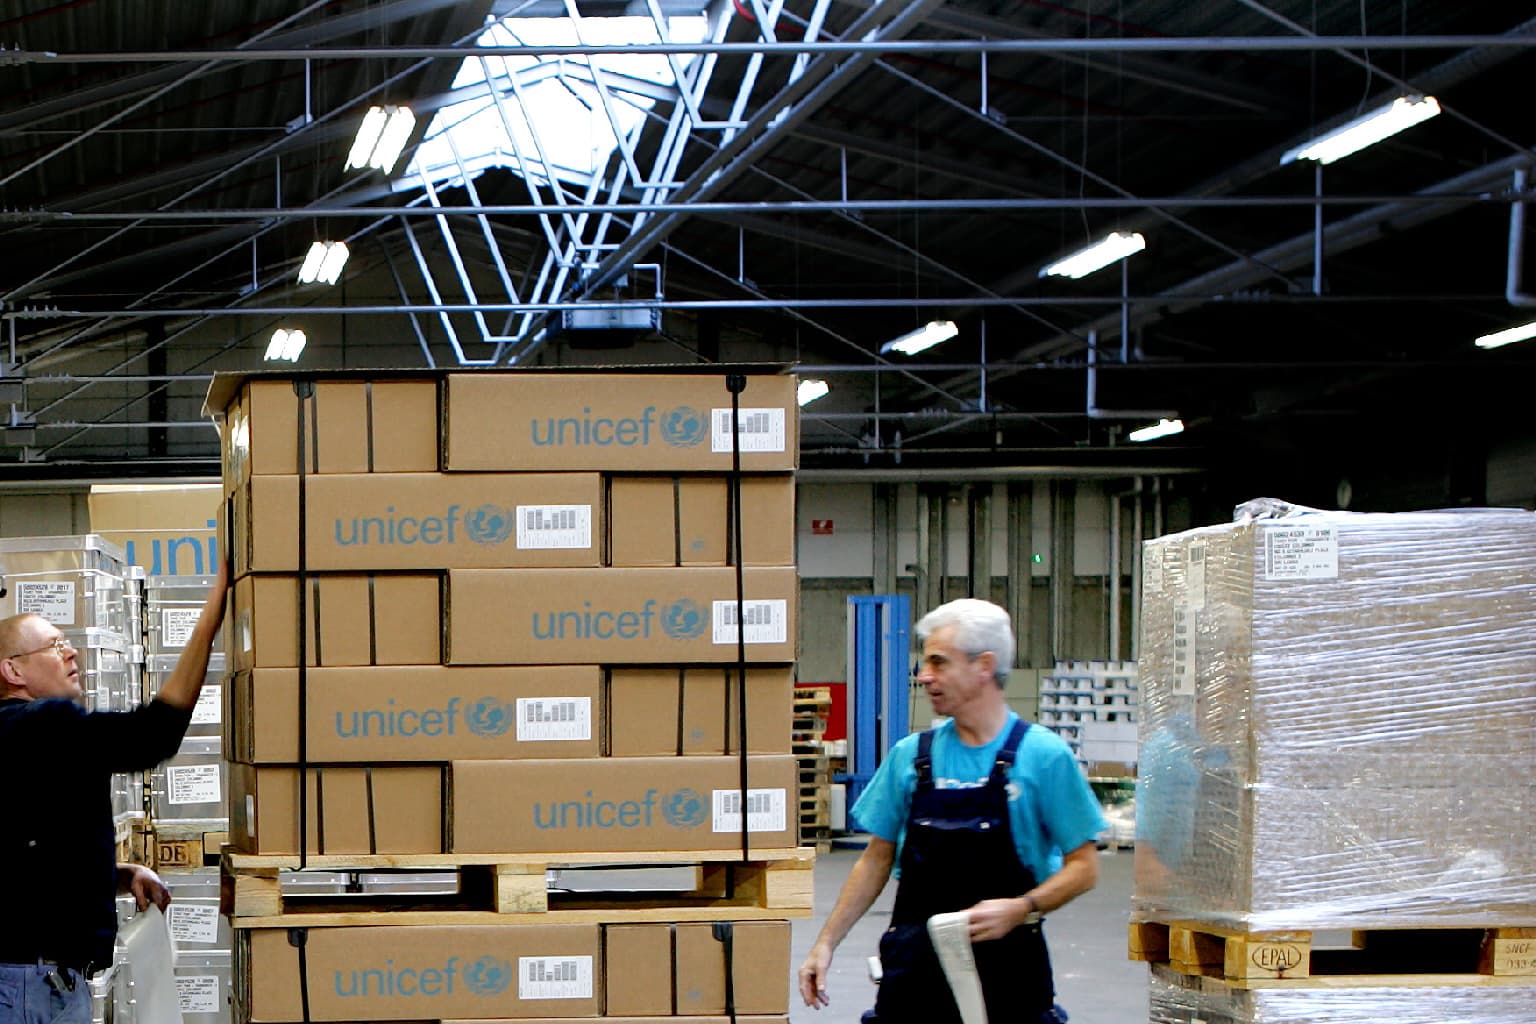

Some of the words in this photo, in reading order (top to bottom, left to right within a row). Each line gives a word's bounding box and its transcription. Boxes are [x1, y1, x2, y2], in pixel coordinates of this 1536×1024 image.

[530, 406, 656, 447] unicef
[335, 504, 460, 547] unicef
[531, 598, 657, 640] unicef
[335, 697, 461, 740] unicef
[533, 789, 657, 830] unicef
[1261, 947, 1292, 966] EPAL
[334, 957, 460, 998] unicef
